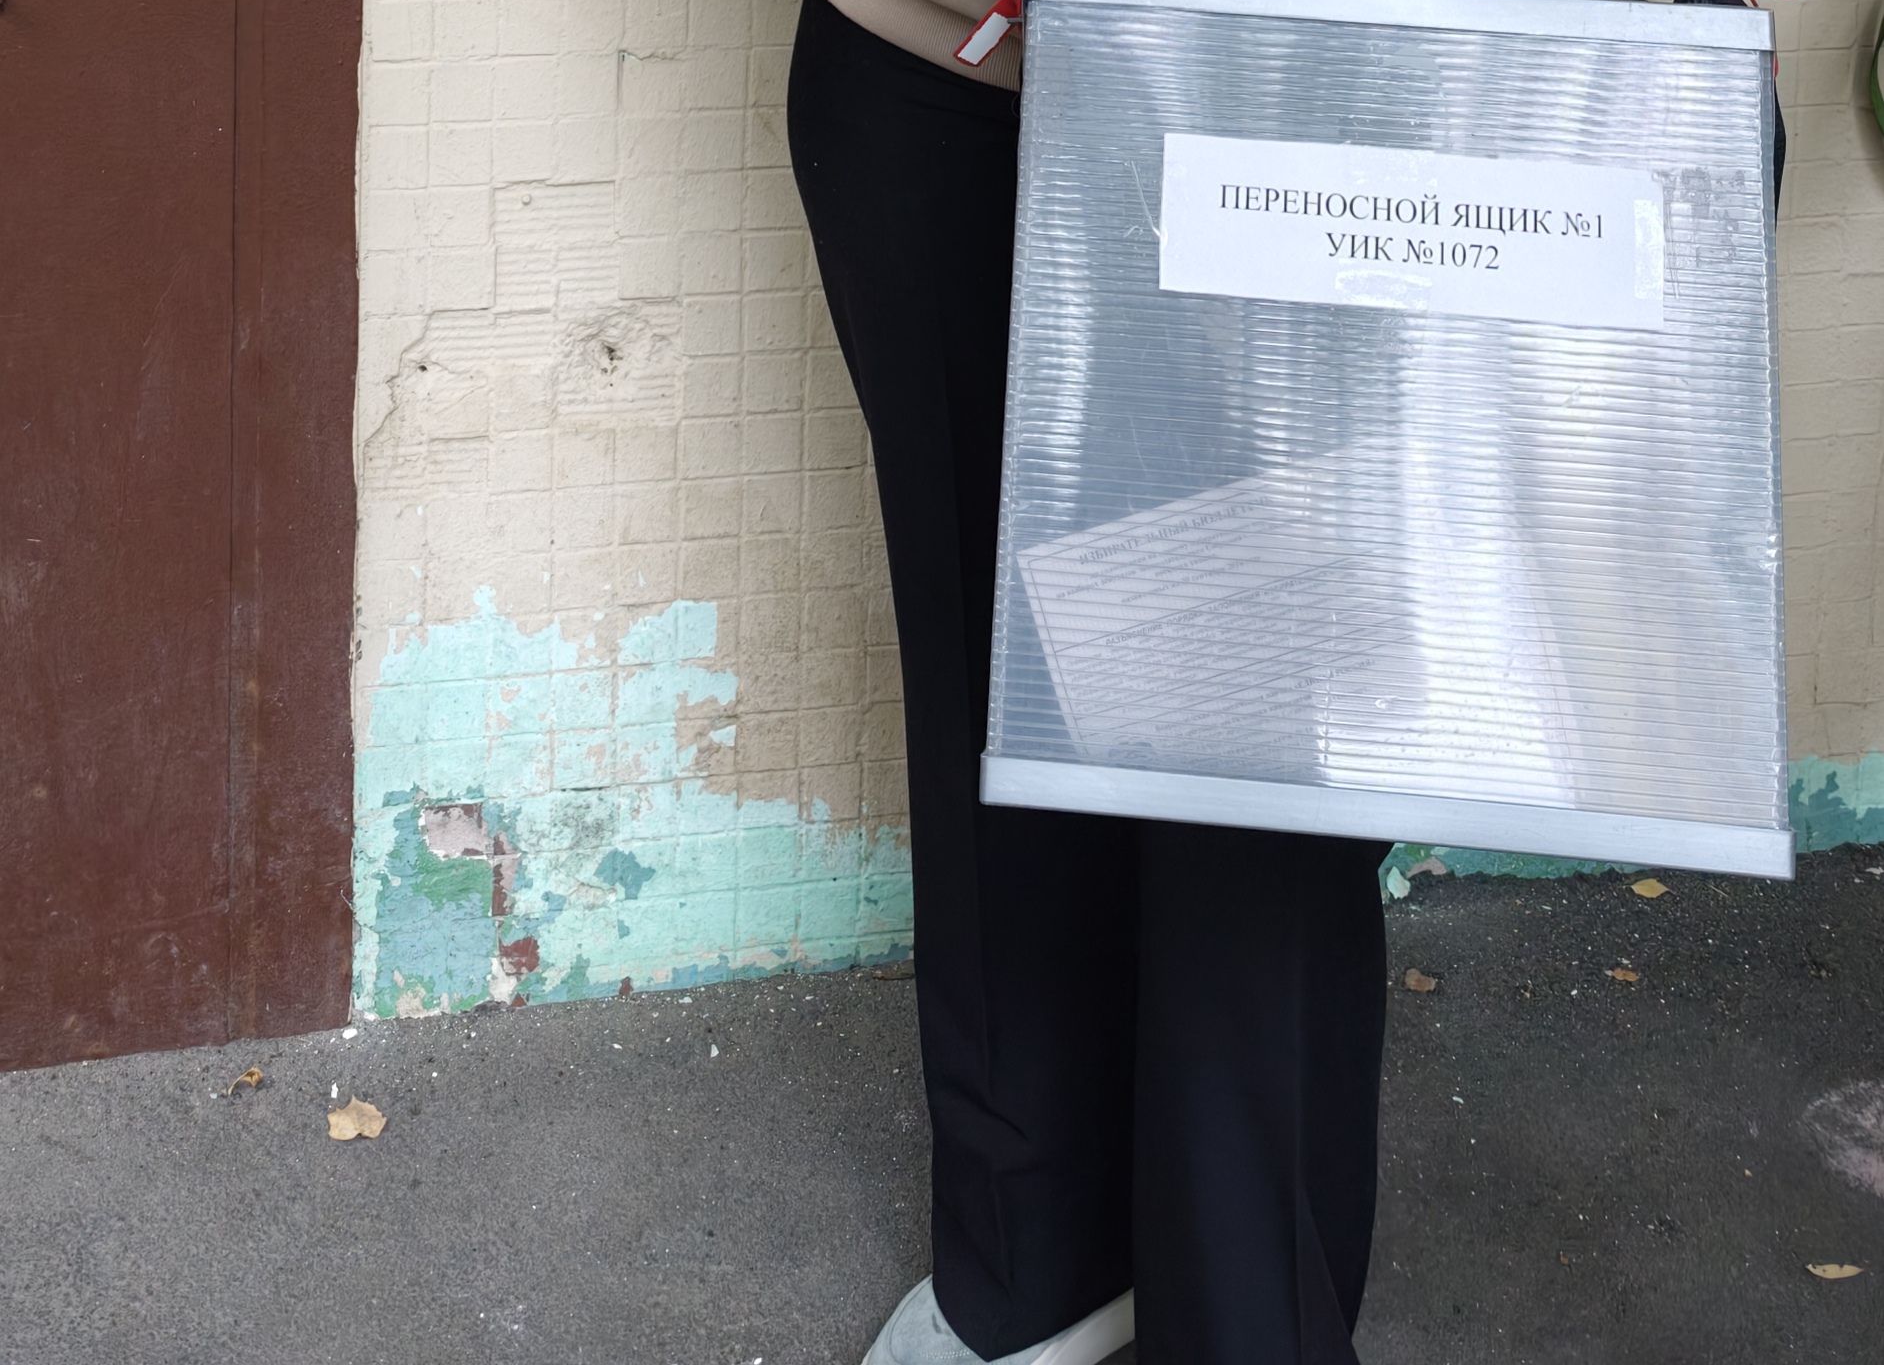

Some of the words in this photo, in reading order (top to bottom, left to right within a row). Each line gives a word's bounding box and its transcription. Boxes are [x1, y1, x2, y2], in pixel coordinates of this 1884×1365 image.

[1218, 183, 1442, 226] ПЕРЕНОСНОЙ
[1451, 203, 1553, 237] ЯЩИК
[1561, 211, 1604, 239] №1
[1325, 232, 1394, 262] УИК
[1402, 238, 1500, 270] №1072
